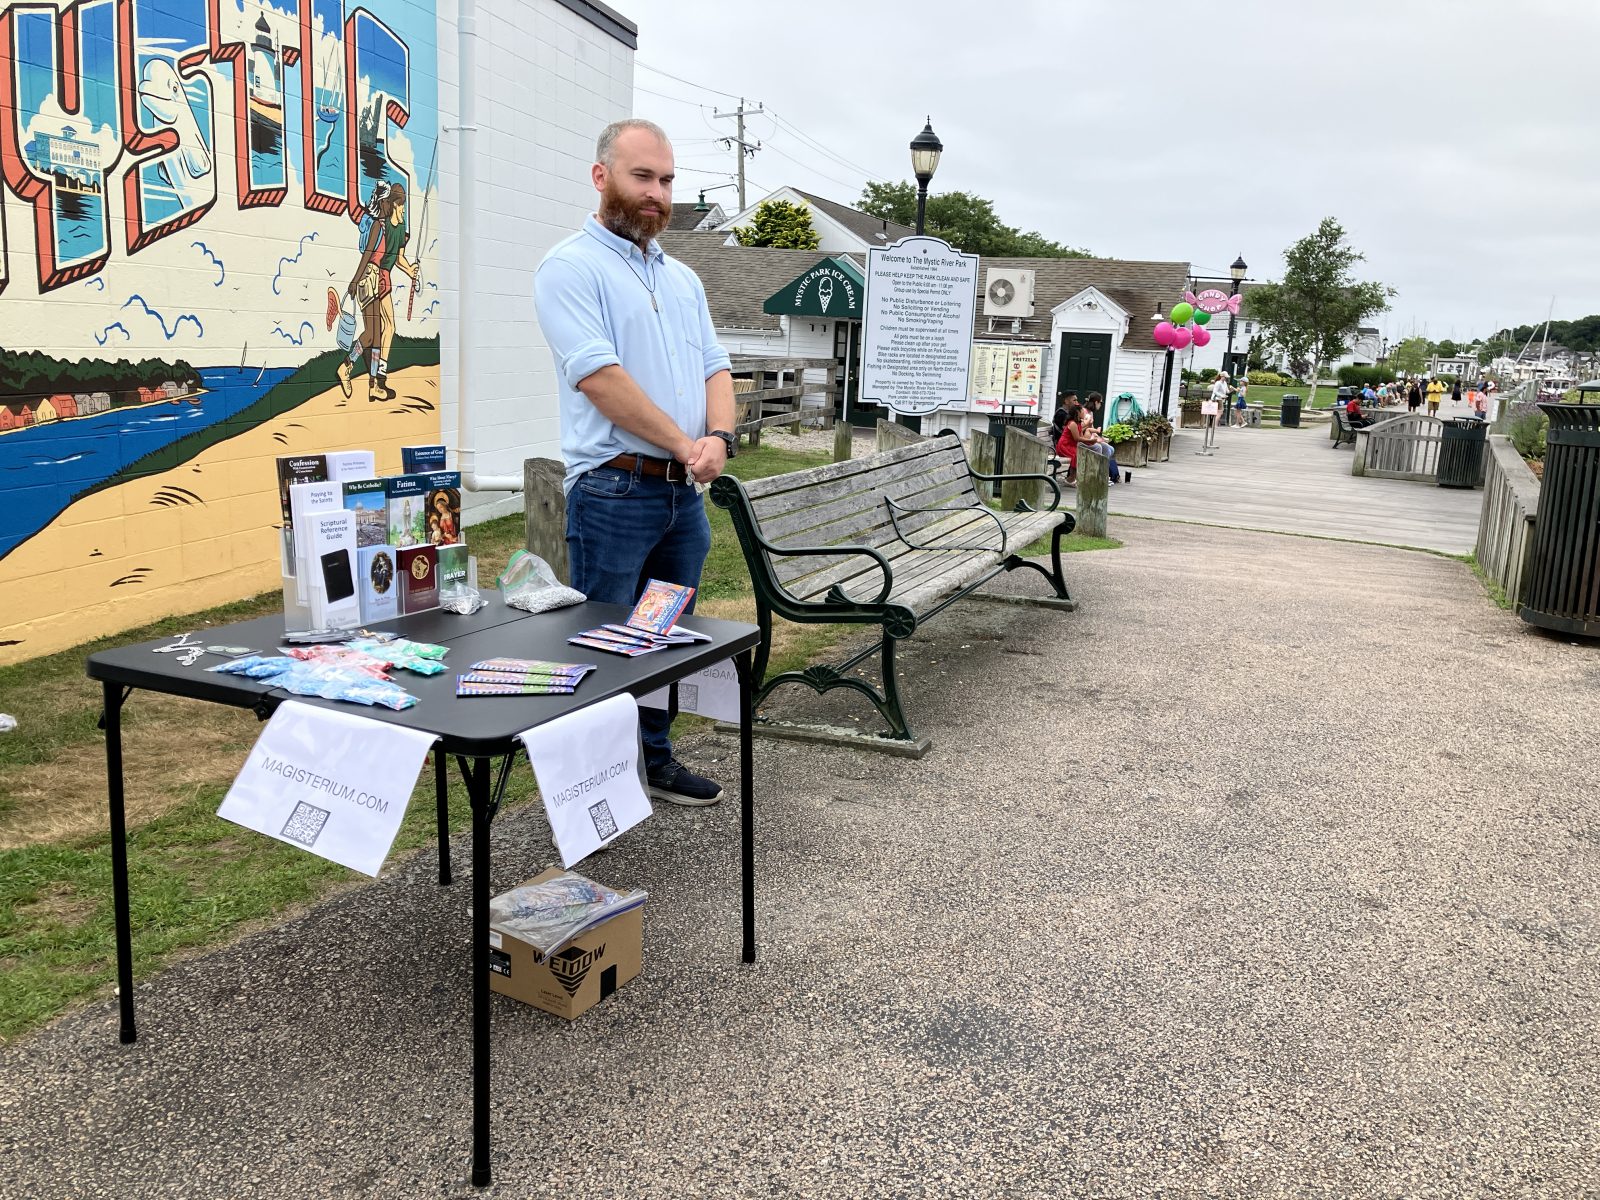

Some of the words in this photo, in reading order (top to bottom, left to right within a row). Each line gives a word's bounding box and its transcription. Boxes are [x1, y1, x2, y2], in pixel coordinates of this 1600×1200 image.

[0, 0, 412, 297] YSTIC
[881, 254, 905, 262] Welcome
[924, 257, 940, 266] Mystic
[795, 276, 812, 306] MYSTIC
[810, 268, 830, 280] PARK
[832, 269, 844, 282] ICE
[842, 280, 856, 309] CREAM
[1198, 292, 1226, 301] CANDY
[320, 519, 347, 527] Scriptural
[444, 571, 466, 580] PRAYER
[261, 756, 389, 815] MAGISTERIUM.COM
[553, 759, 629, 808] MAGISTERIUM.COM
